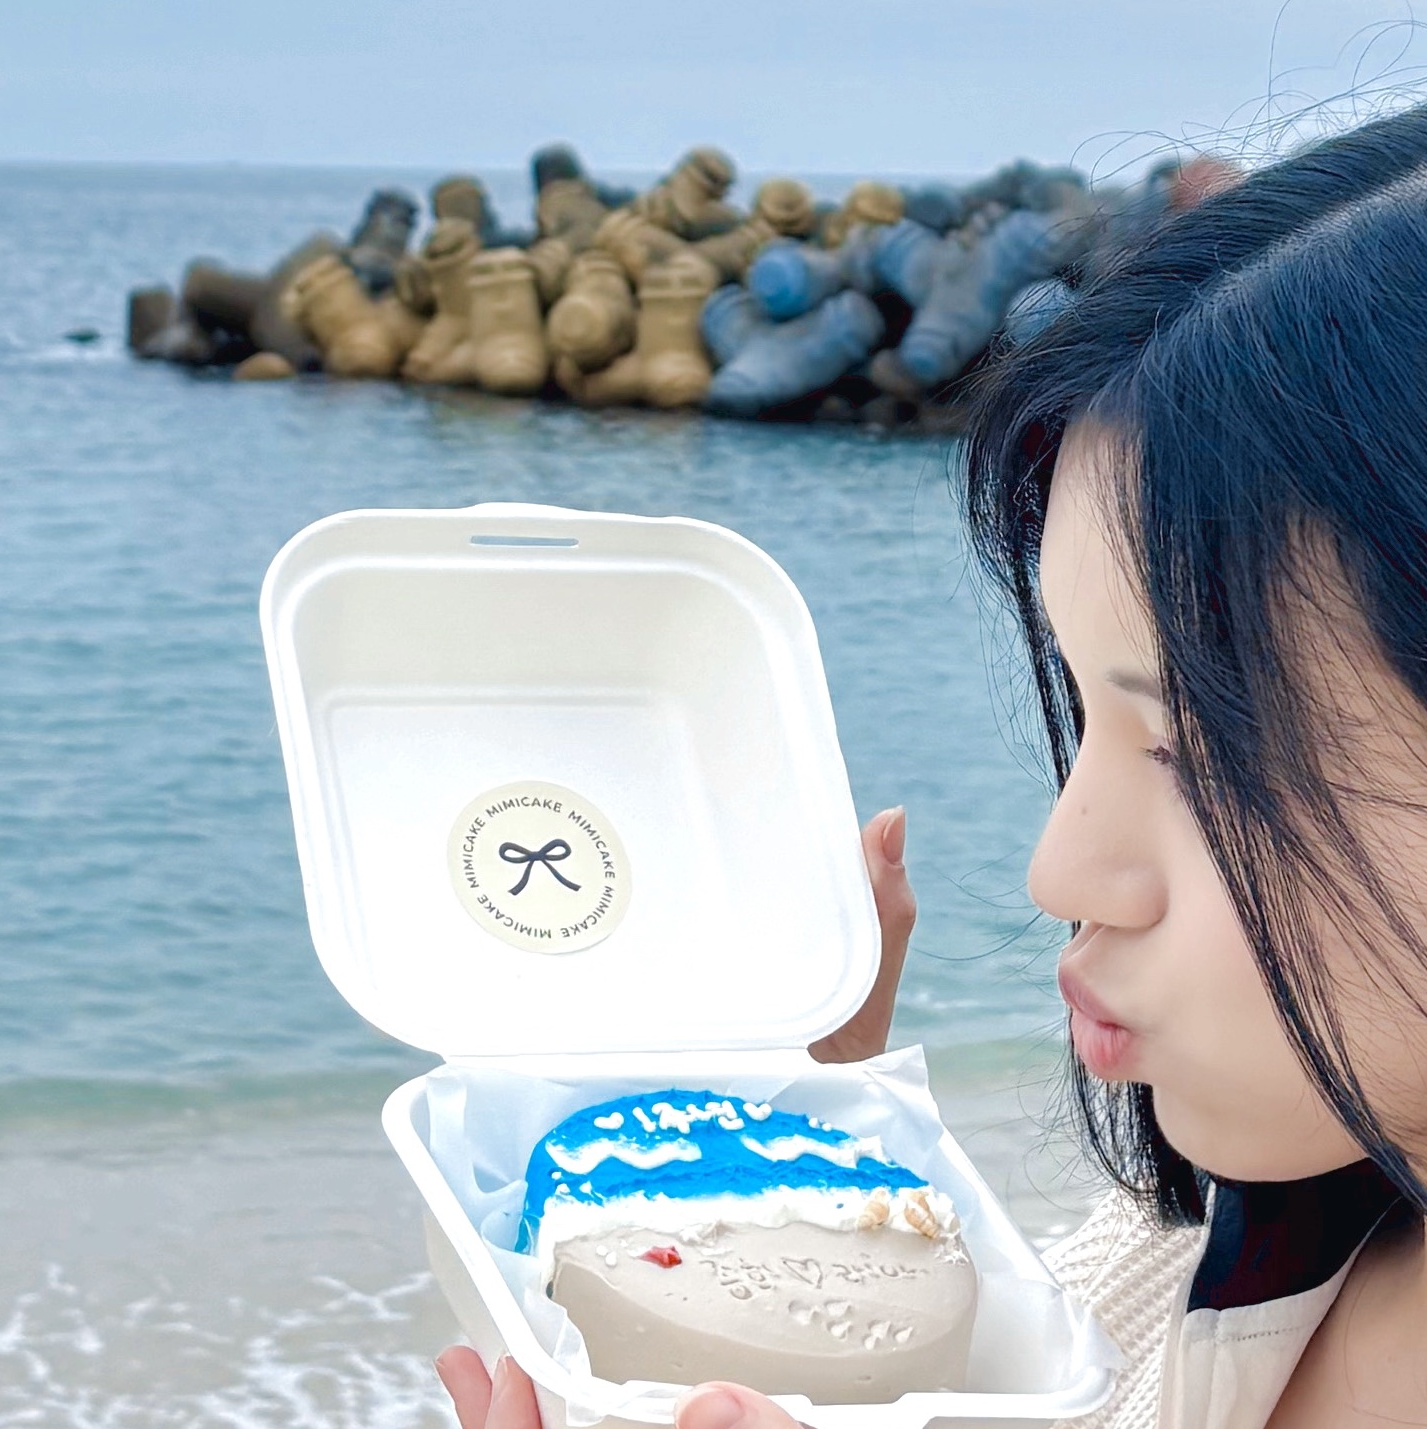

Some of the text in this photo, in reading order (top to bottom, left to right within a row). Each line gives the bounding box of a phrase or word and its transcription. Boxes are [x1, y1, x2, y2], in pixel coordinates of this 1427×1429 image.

[462, 796, 616, 939] MIMICAKE MIMICAKE MIMICAKE MIMICAKE MIMICAKE
